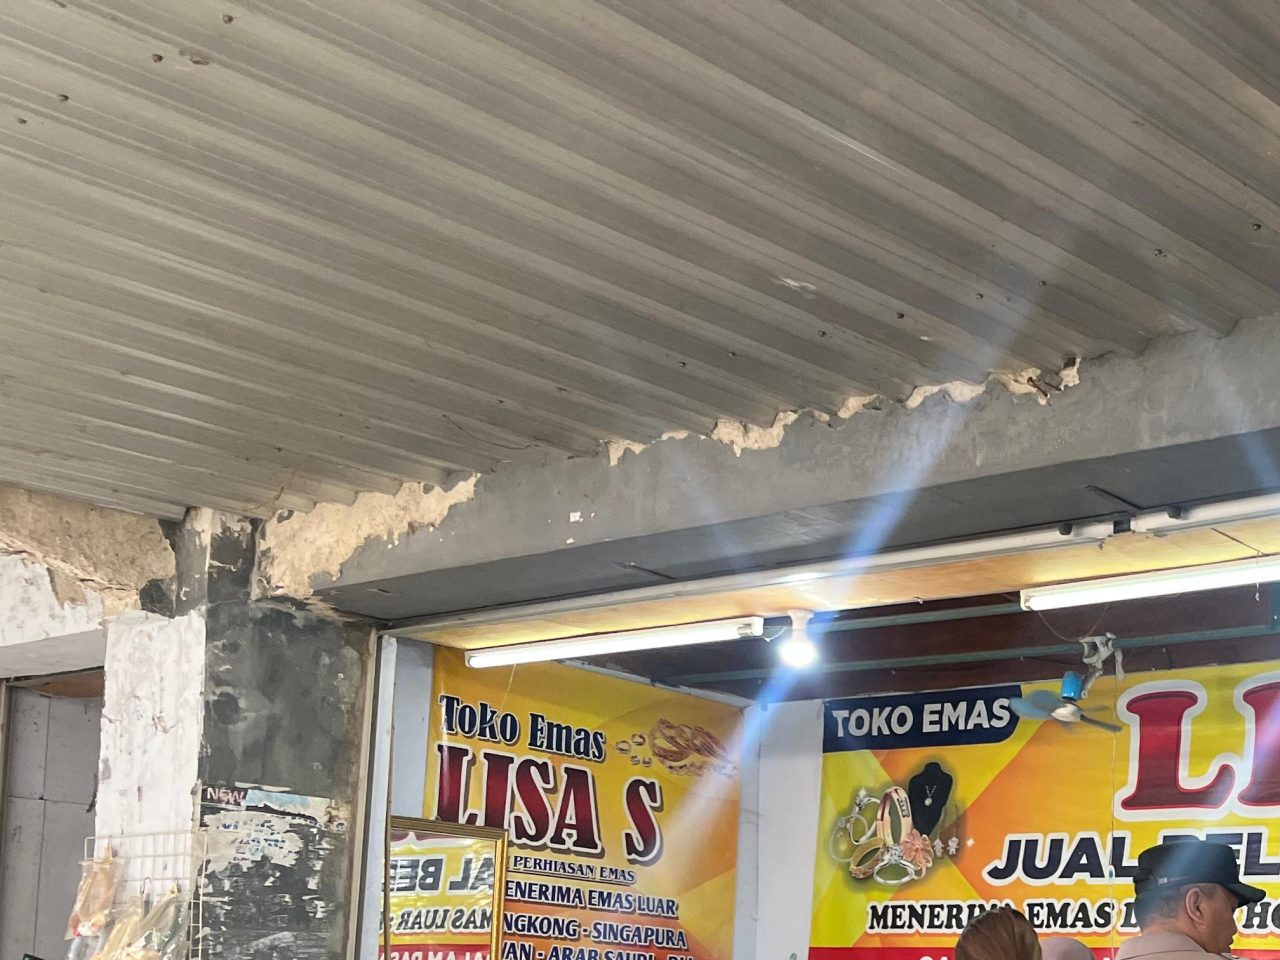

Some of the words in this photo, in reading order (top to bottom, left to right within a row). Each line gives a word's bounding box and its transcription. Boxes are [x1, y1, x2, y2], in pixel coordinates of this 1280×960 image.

[440, 696, 517, 743] Toko
[528, 713, 605, 761] Emas
[832, 707, 914, 738] TOKO
[922, 697, 1012, 733] EMAS
[437, 745, 601, 852] LISA
[624, 778, 659, 860] S
[513, 855, 595, 877] PERHIASAN
[599, 866, 635, 883] EMAS
[987, 836, 1140, 880] JUAL
[505, 880, 584, 906] ENERIMA
[588, 889, 633, 911] EMAS
[637, 895, 677, 916] LUAR
[869, 902, 1012, 930] MENERI
[1026, 901, 1114, 930] EMAS
[503, 913, 579, 939] NGKONG
[593, 921, 688, 948] SINGAPURA
